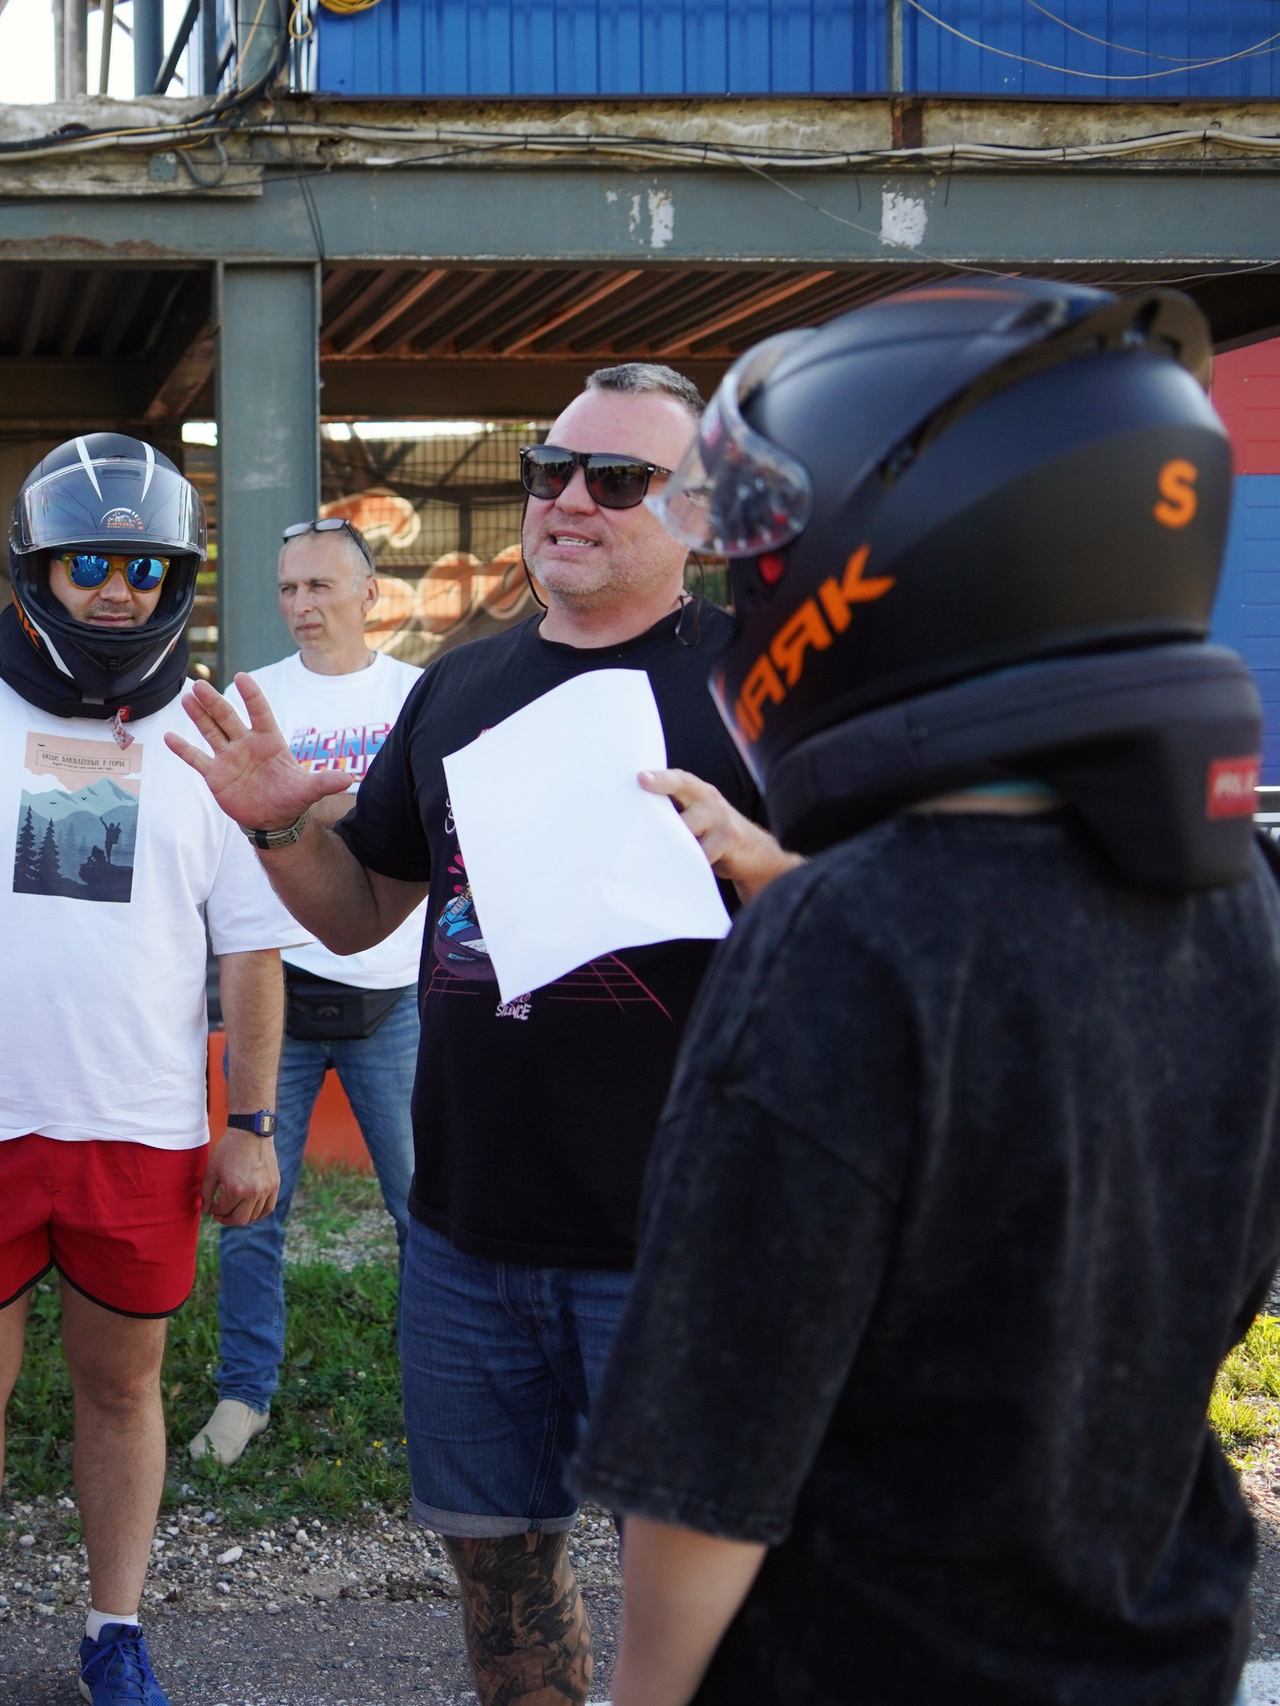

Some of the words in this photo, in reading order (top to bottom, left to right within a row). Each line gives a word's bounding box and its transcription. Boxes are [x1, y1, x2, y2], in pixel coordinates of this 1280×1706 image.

[1153, 458, 1198, 529] S
[290, 722, 391, 761] RACING
[309, 752, 378, 774] CLU
[495, 1002, 532, 1020] SILENCE
